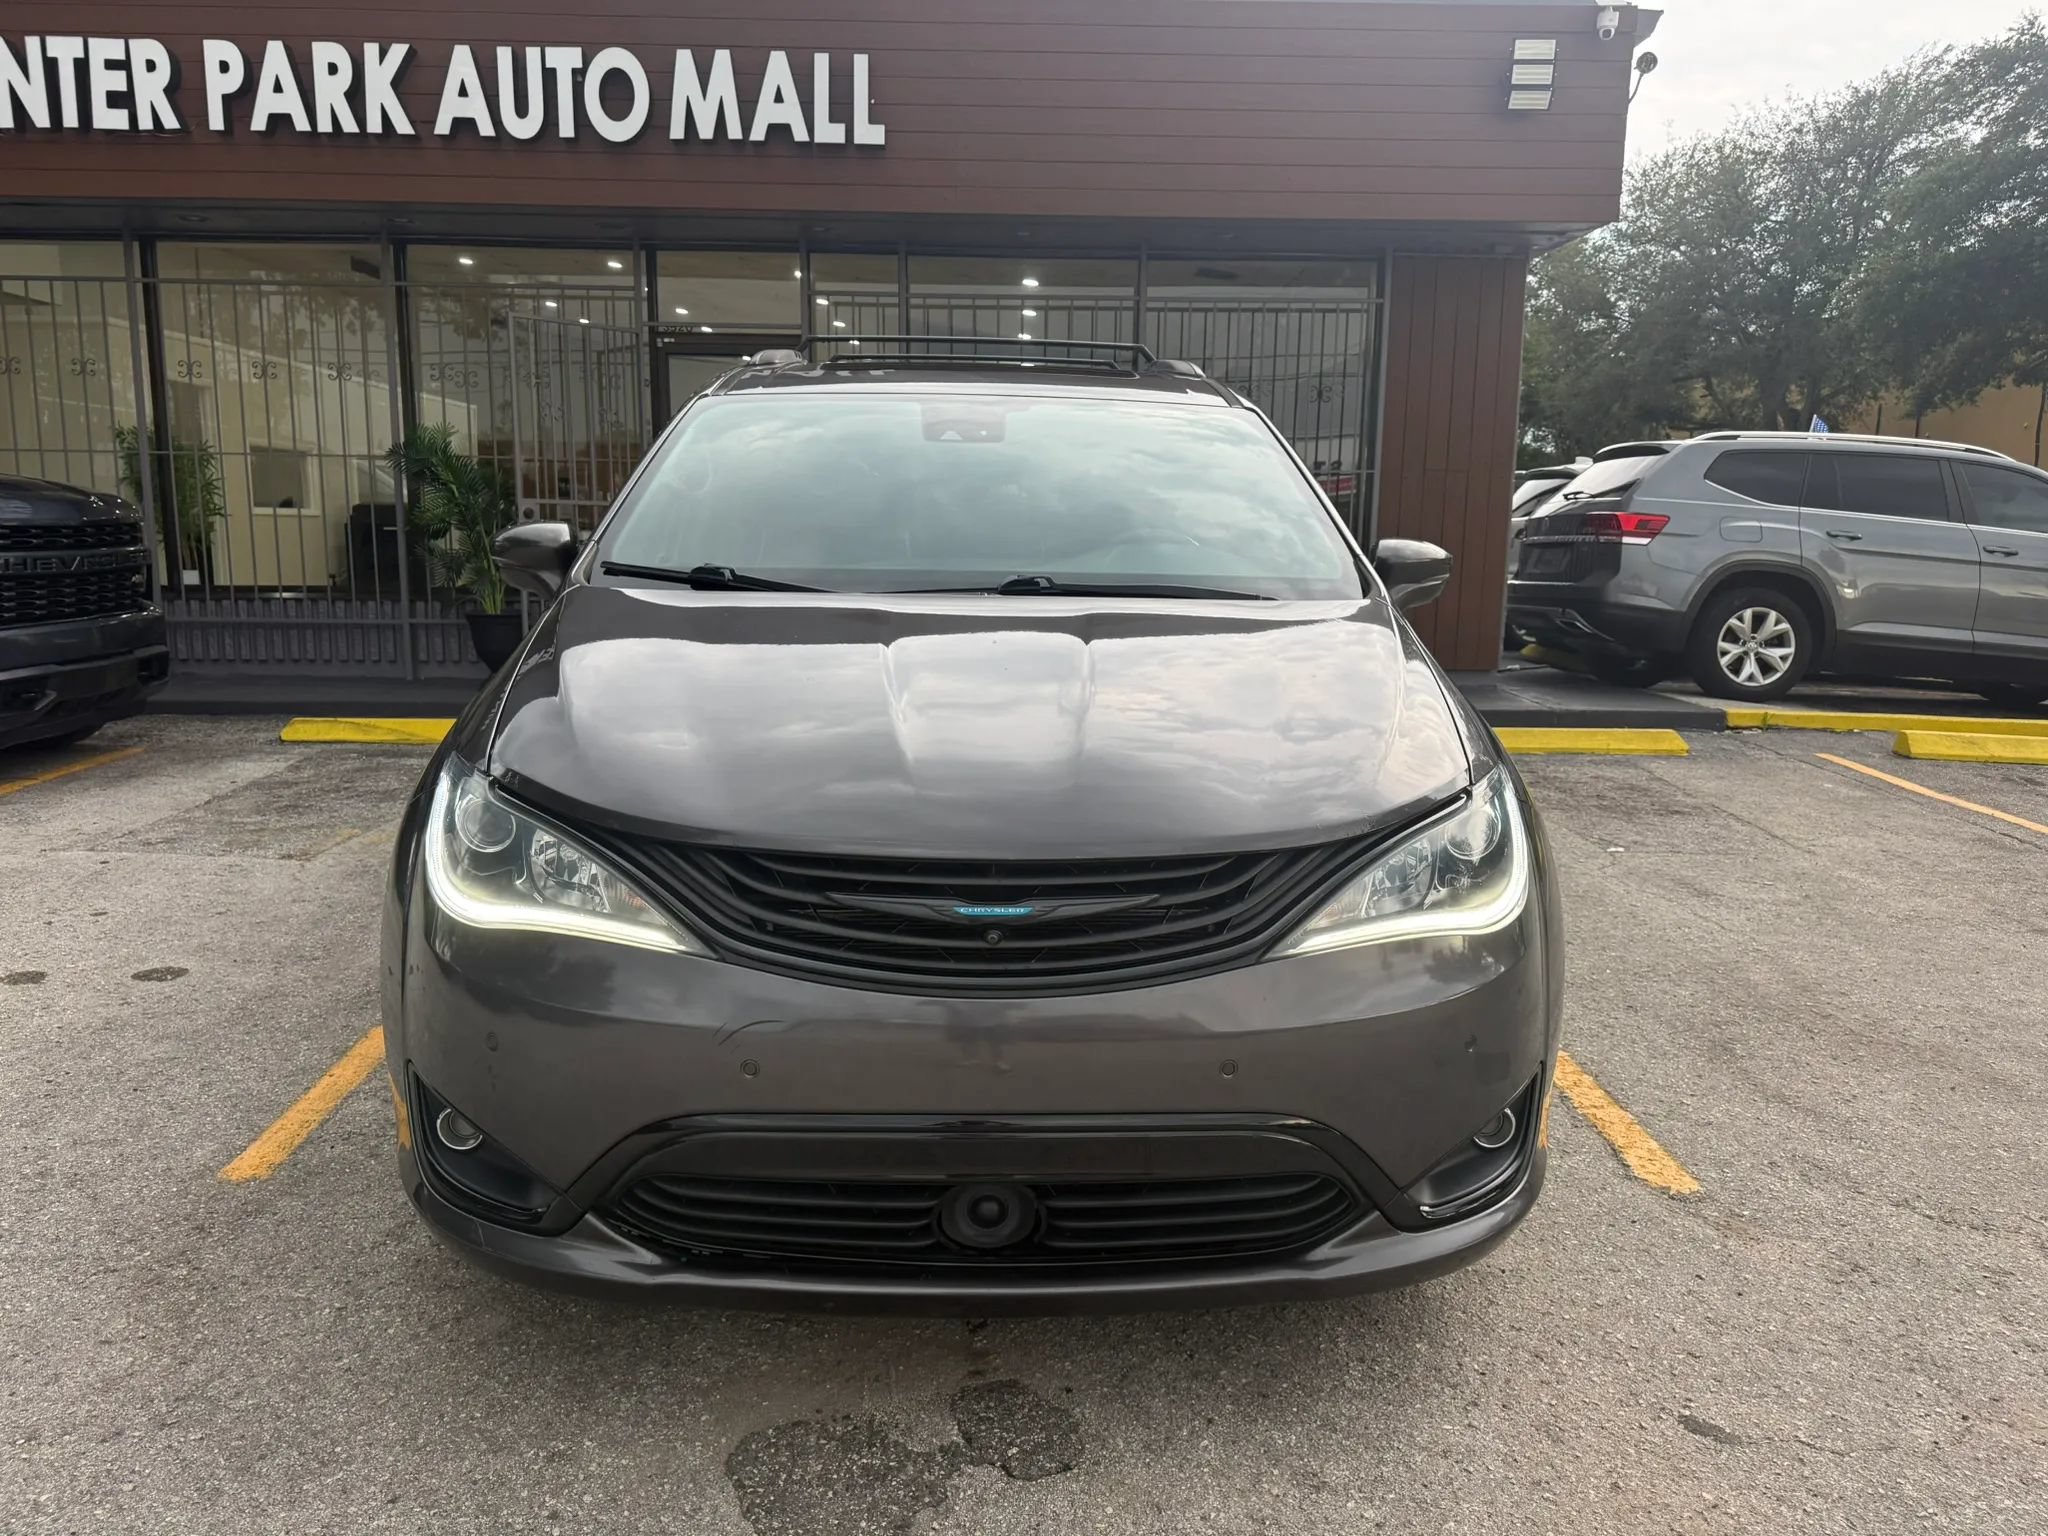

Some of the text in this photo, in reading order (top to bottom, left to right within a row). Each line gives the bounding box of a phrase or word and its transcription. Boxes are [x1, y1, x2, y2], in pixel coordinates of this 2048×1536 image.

[203, 40, 416, 135] PARK
[434, 45, 650, 142] AUTO
[670, 49, 886, 145] MALL
